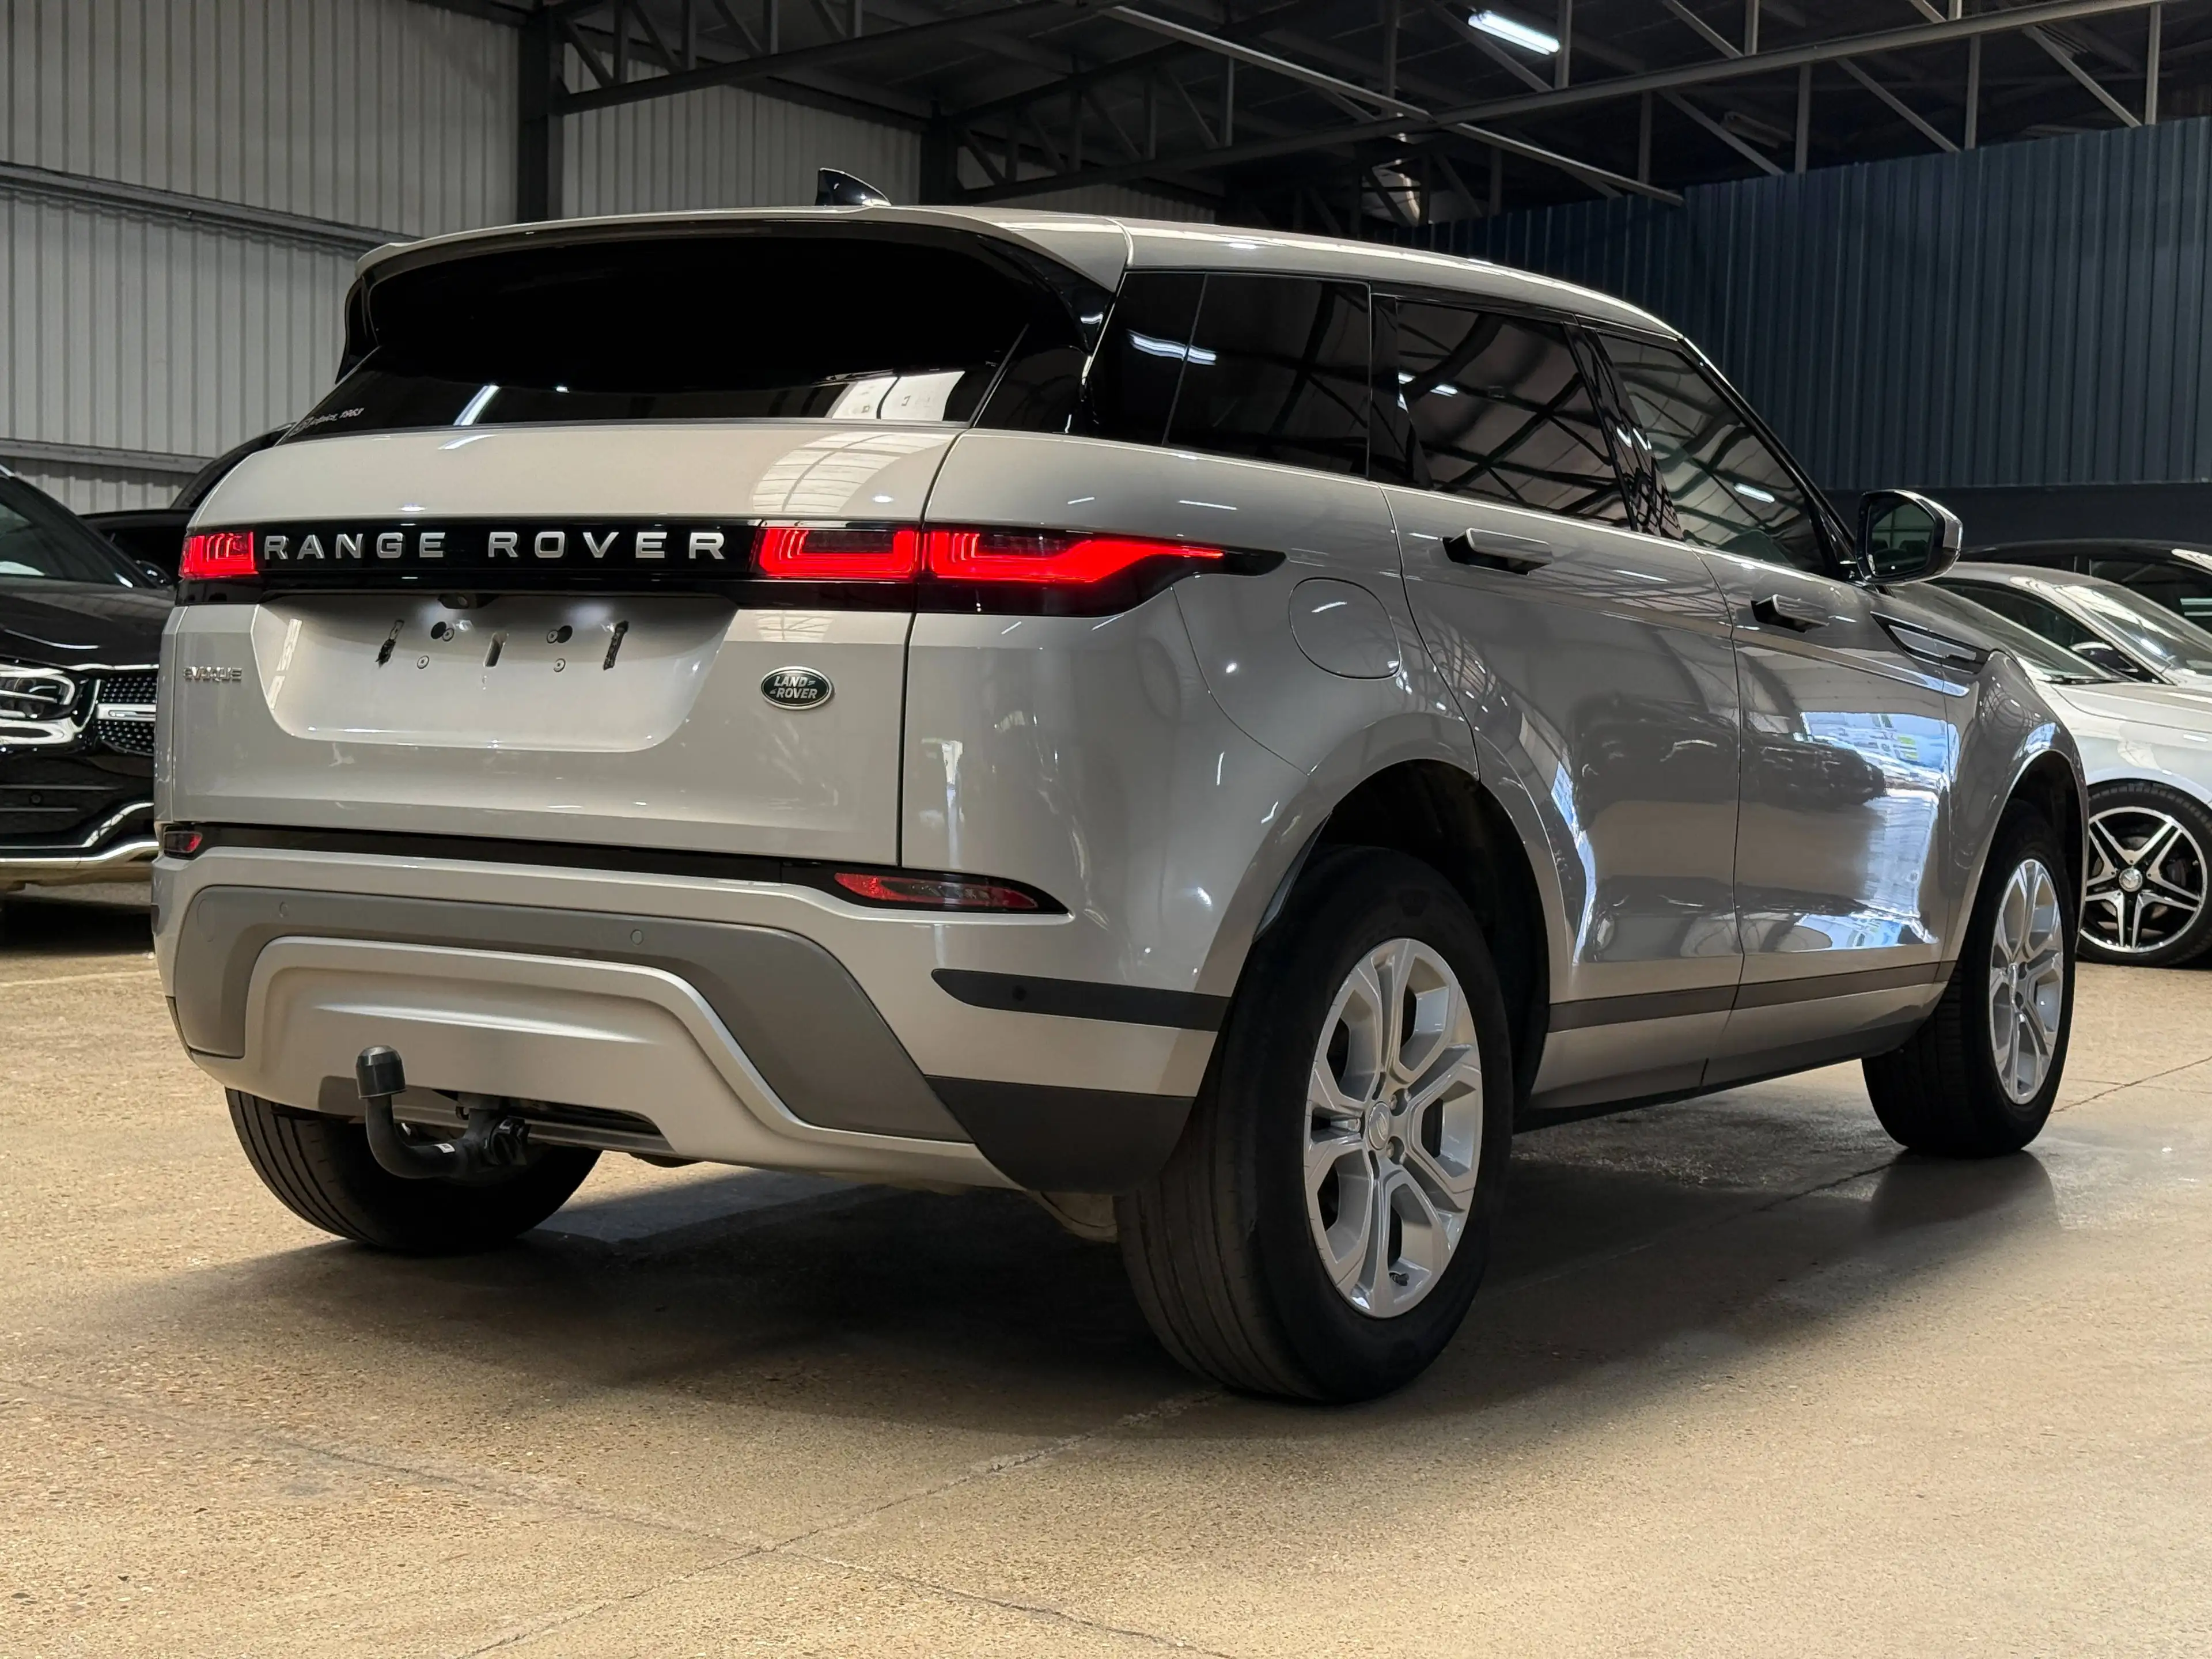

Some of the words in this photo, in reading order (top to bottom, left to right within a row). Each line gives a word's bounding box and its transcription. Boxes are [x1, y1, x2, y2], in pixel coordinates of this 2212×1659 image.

[264, 532, 446, 560] RANGE
[488, 531, 725, 560] ROVER
[774, 676, 808, 687] LAND
[776, 687, 818, 699] ROVER
